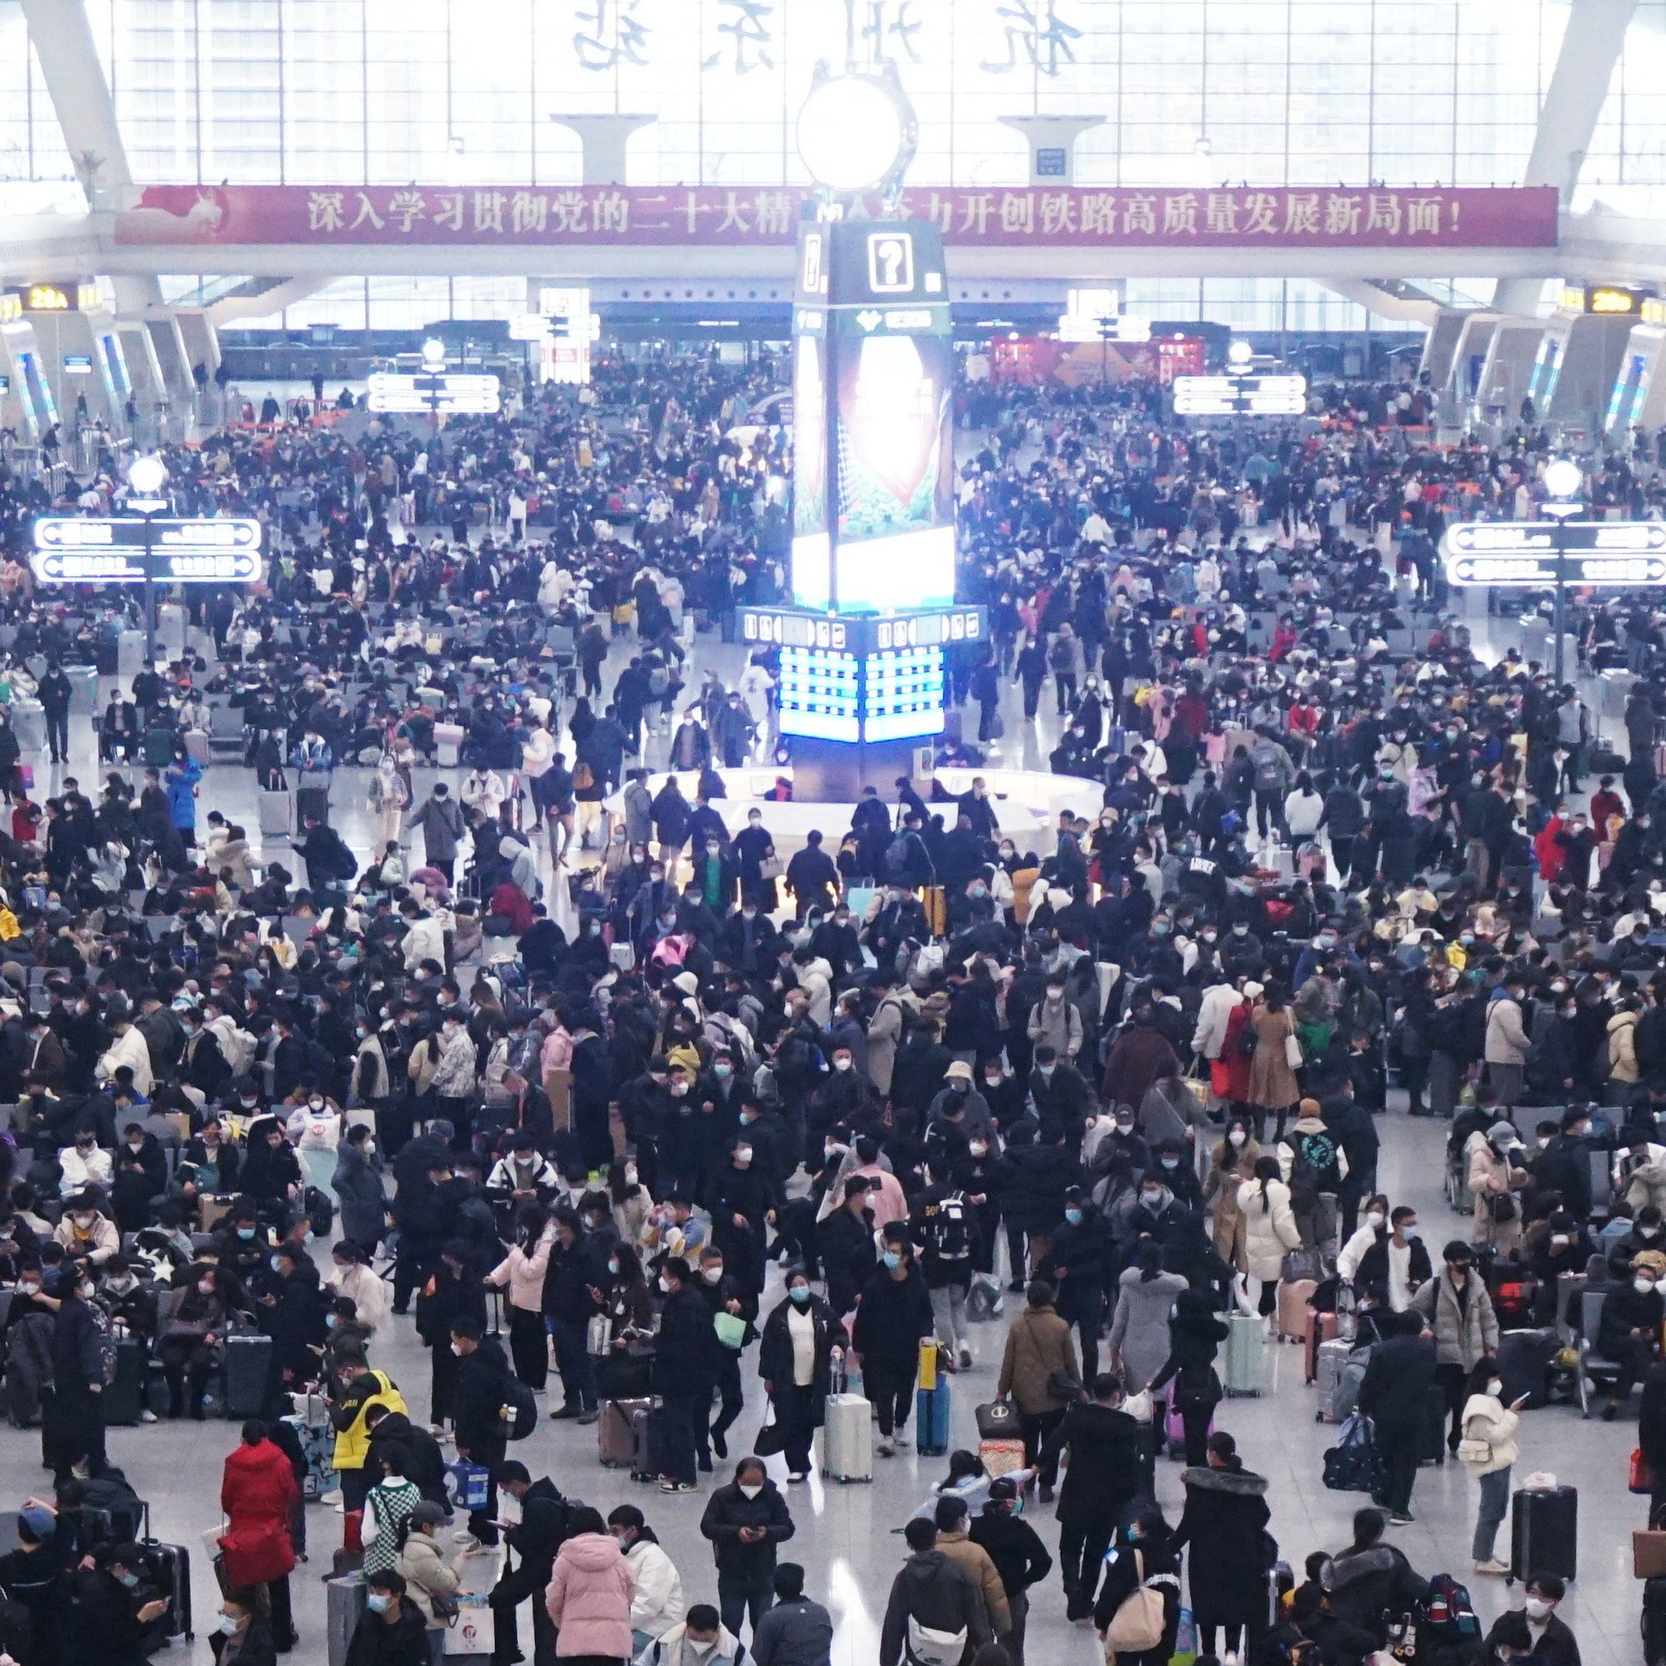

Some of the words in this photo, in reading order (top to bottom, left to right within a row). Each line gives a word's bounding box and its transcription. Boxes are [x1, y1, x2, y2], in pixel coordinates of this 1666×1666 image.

[307, 190, 809, 235] 深入学习贯彻党的二十大精
